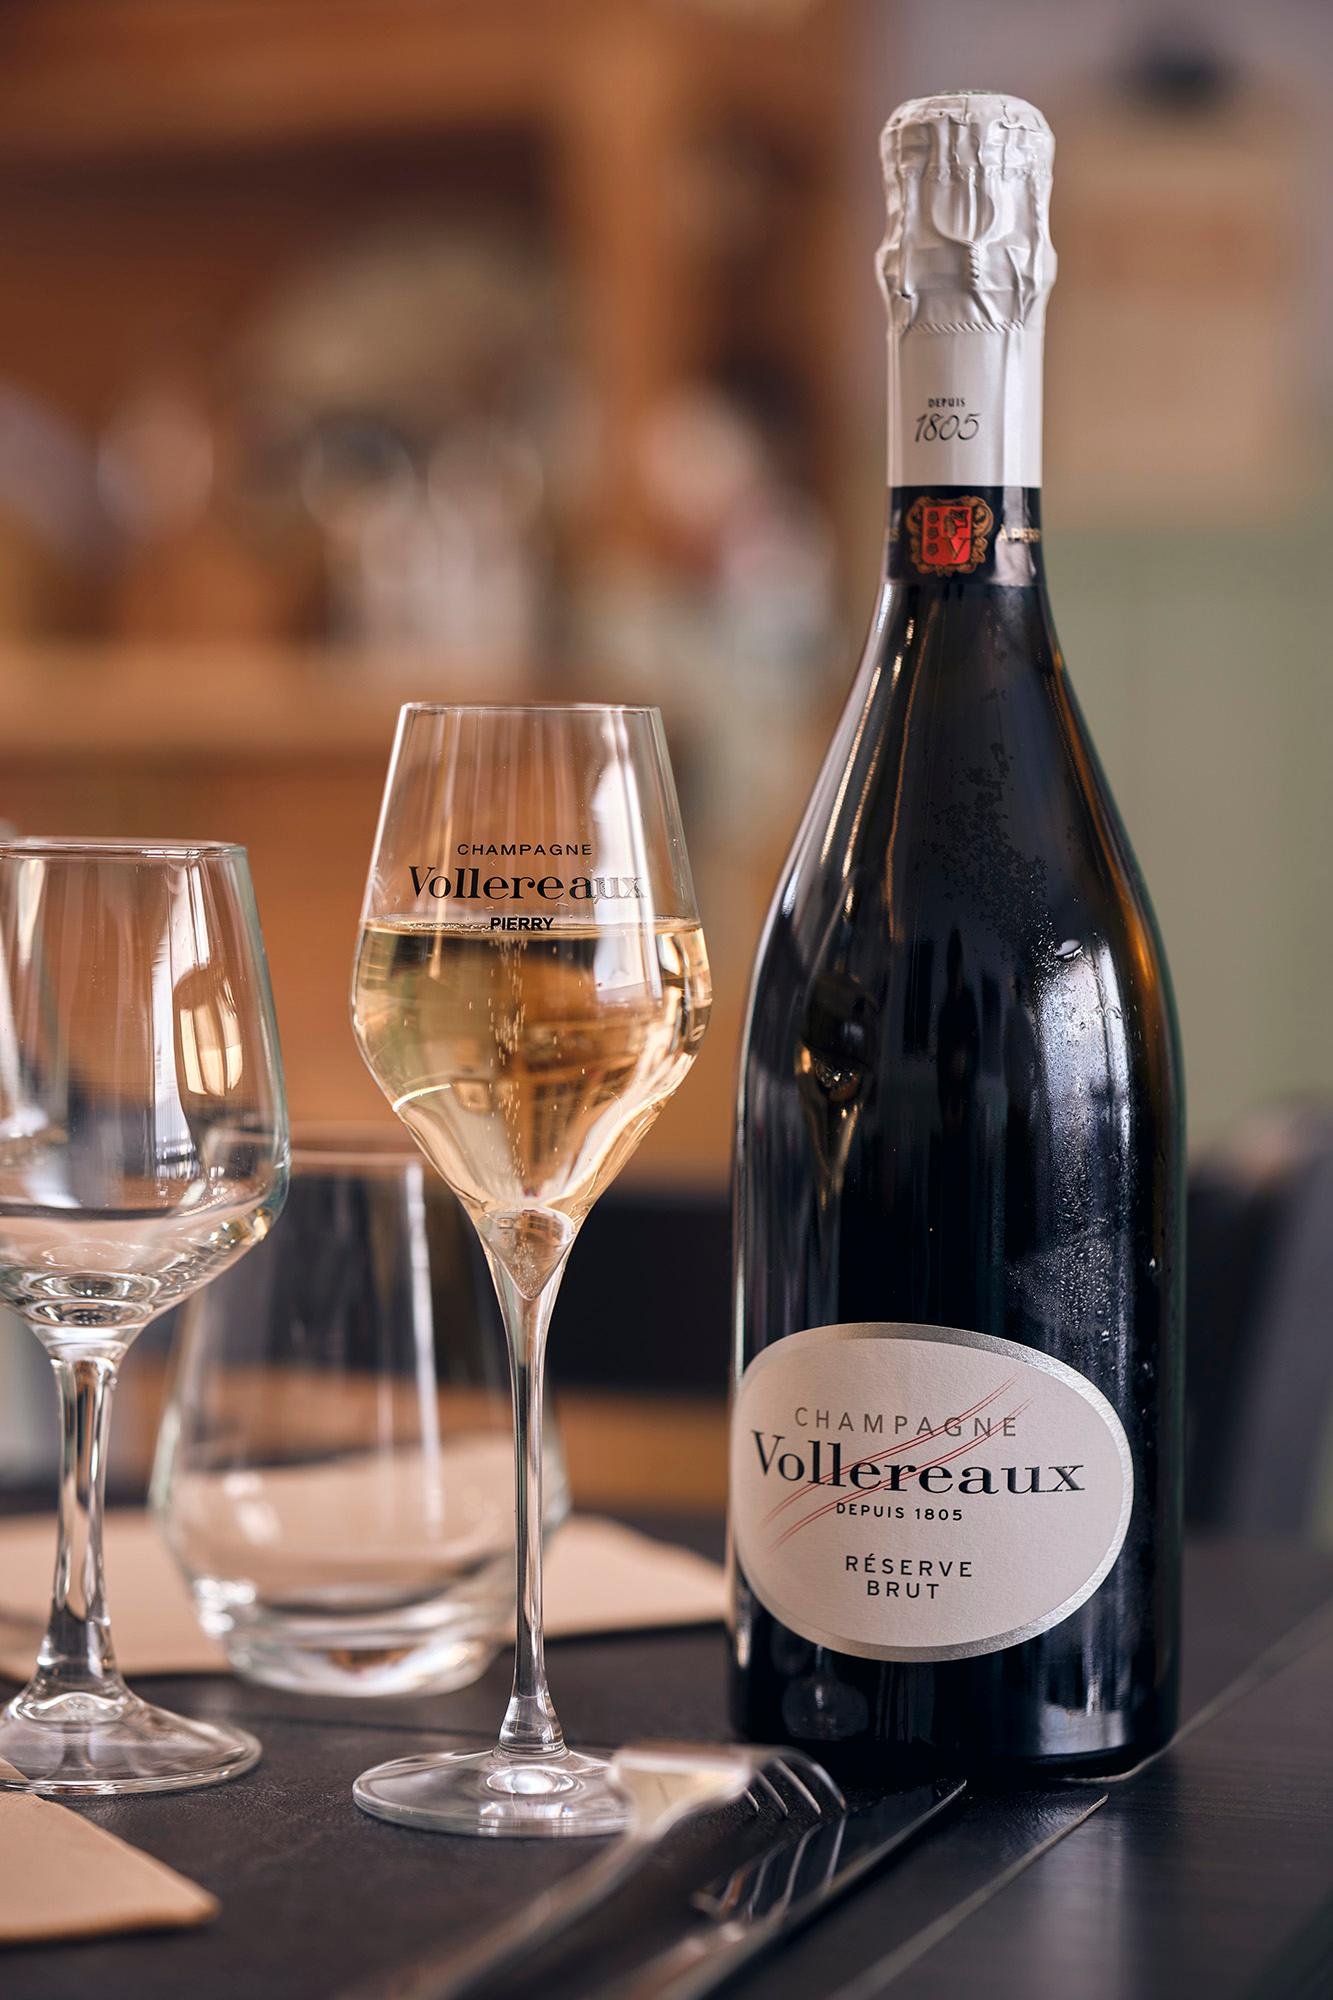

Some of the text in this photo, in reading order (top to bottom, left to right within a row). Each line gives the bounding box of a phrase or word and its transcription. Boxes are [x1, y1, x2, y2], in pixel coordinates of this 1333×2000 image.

[927, 397, 966, 408] DEPUIS
[914, 413, 981, 443] 1805
[457, 843, 593, 856] CHAMPAGNE
[408, 865, 648, 900] Vollereaux
[490, 916, 554, 931] PIERRY
[794, 1406, 1017, 1438] CHAMPAGNE
[751, 1429, 1085, 1495] Vollereaux
[836, 1502, 963, 1522] DEPUIS 1805
[845, 1553, 973, 1578] RÉSERVE
[866, 1580, 940, 1600] BRUT
